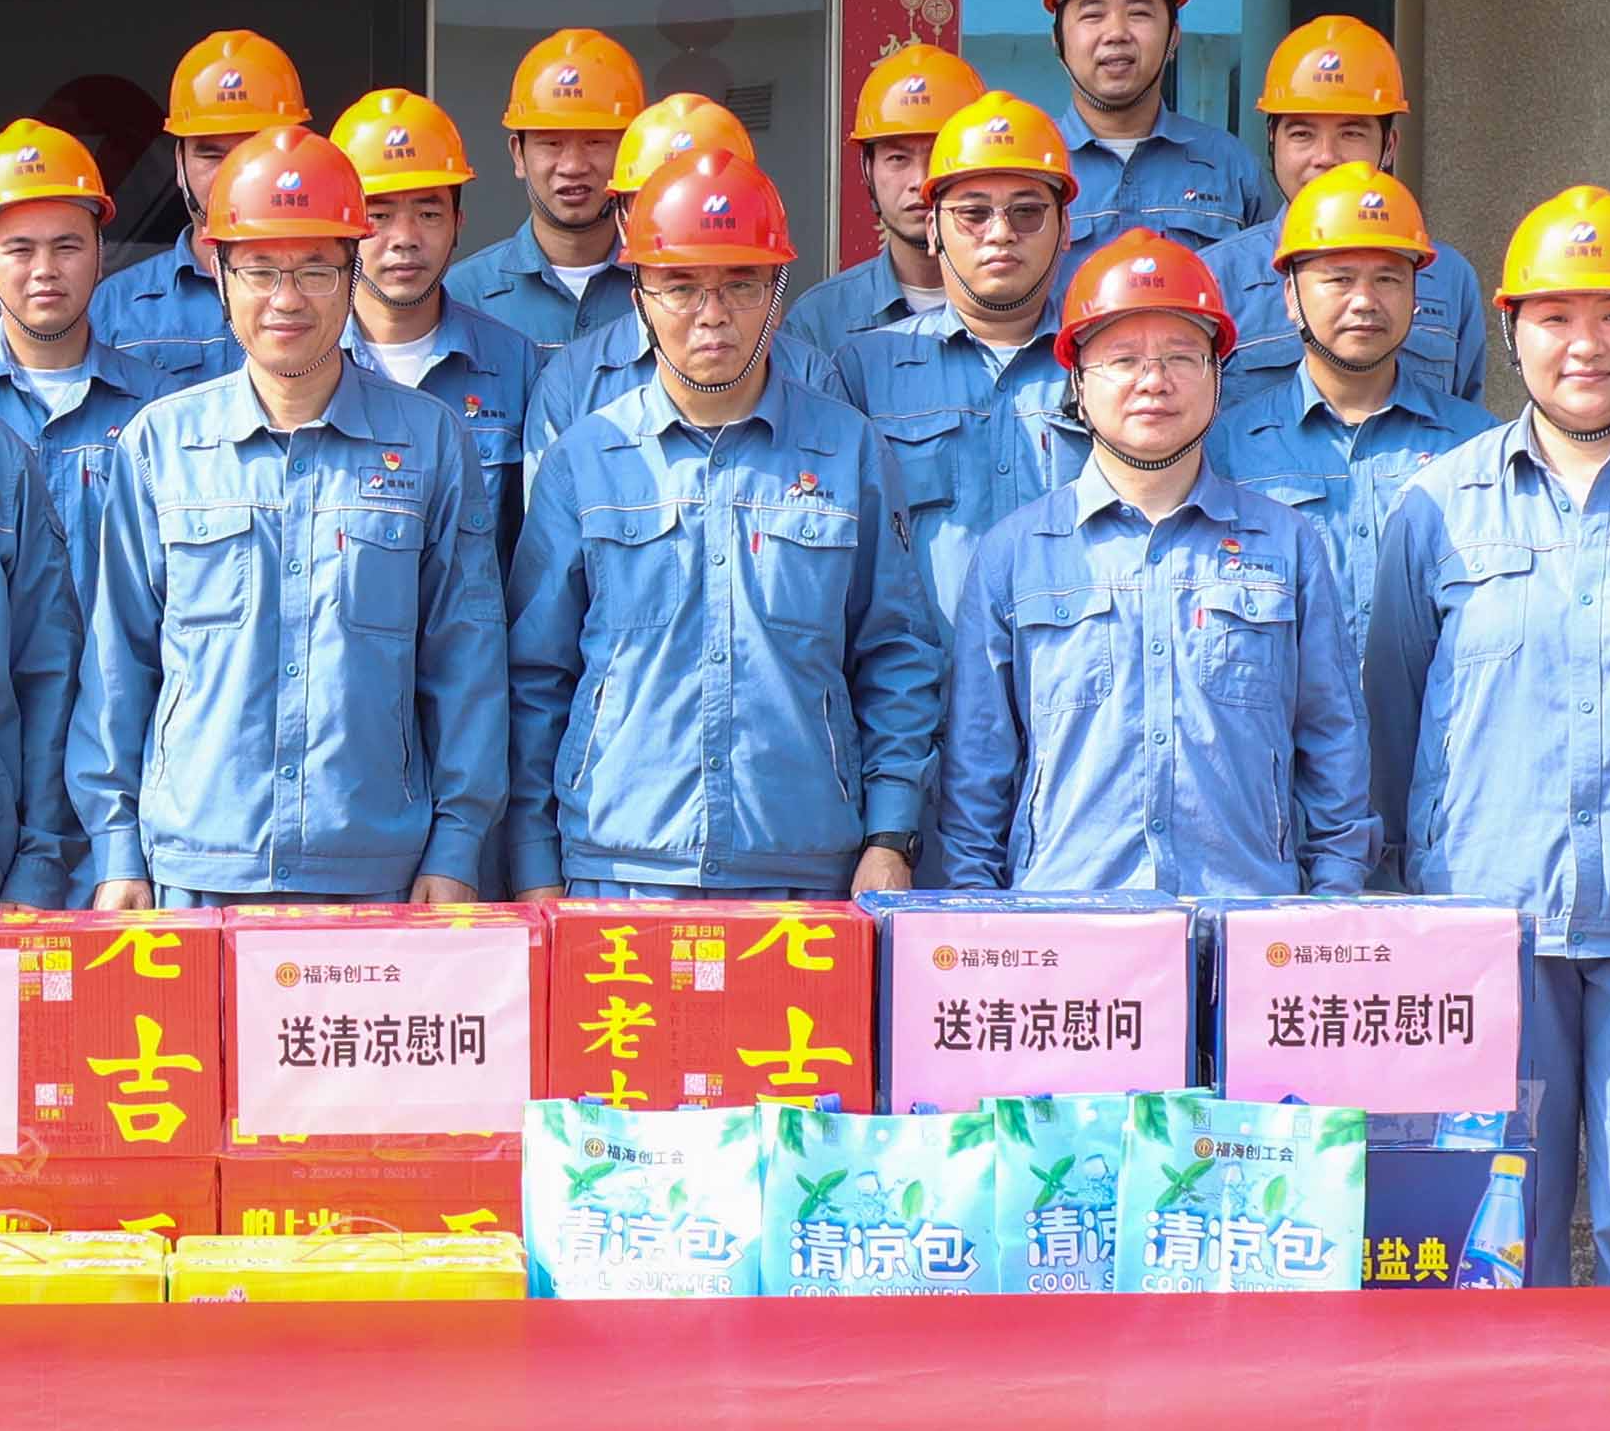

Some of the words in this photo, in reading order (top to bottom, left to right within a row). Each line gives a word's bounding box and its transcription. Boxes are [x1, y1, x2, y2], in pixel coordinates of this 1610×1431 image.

[961, 949, 1059, 969] 福海创工会
[1294, 944, 1393, 966] 福海创工会
[303, 964, 401, 985] 福海创工会
[933, 998, 1143, 1053] 送清凉慰问
[1267, 994, 1476, 1049] 送清凉慰问
[278, 1014, 487, 1069] 送清凉慰问
[606, 1142, 686, 1164] 福海创工会
[1215, 1141, 1295, 1163] 福海创工会
[789, 1220, 981, 1281] 清凉包
[1143, 1211, 1335, 1280] 清凉包
[1028, 1273, 1091, 1292] COOL
